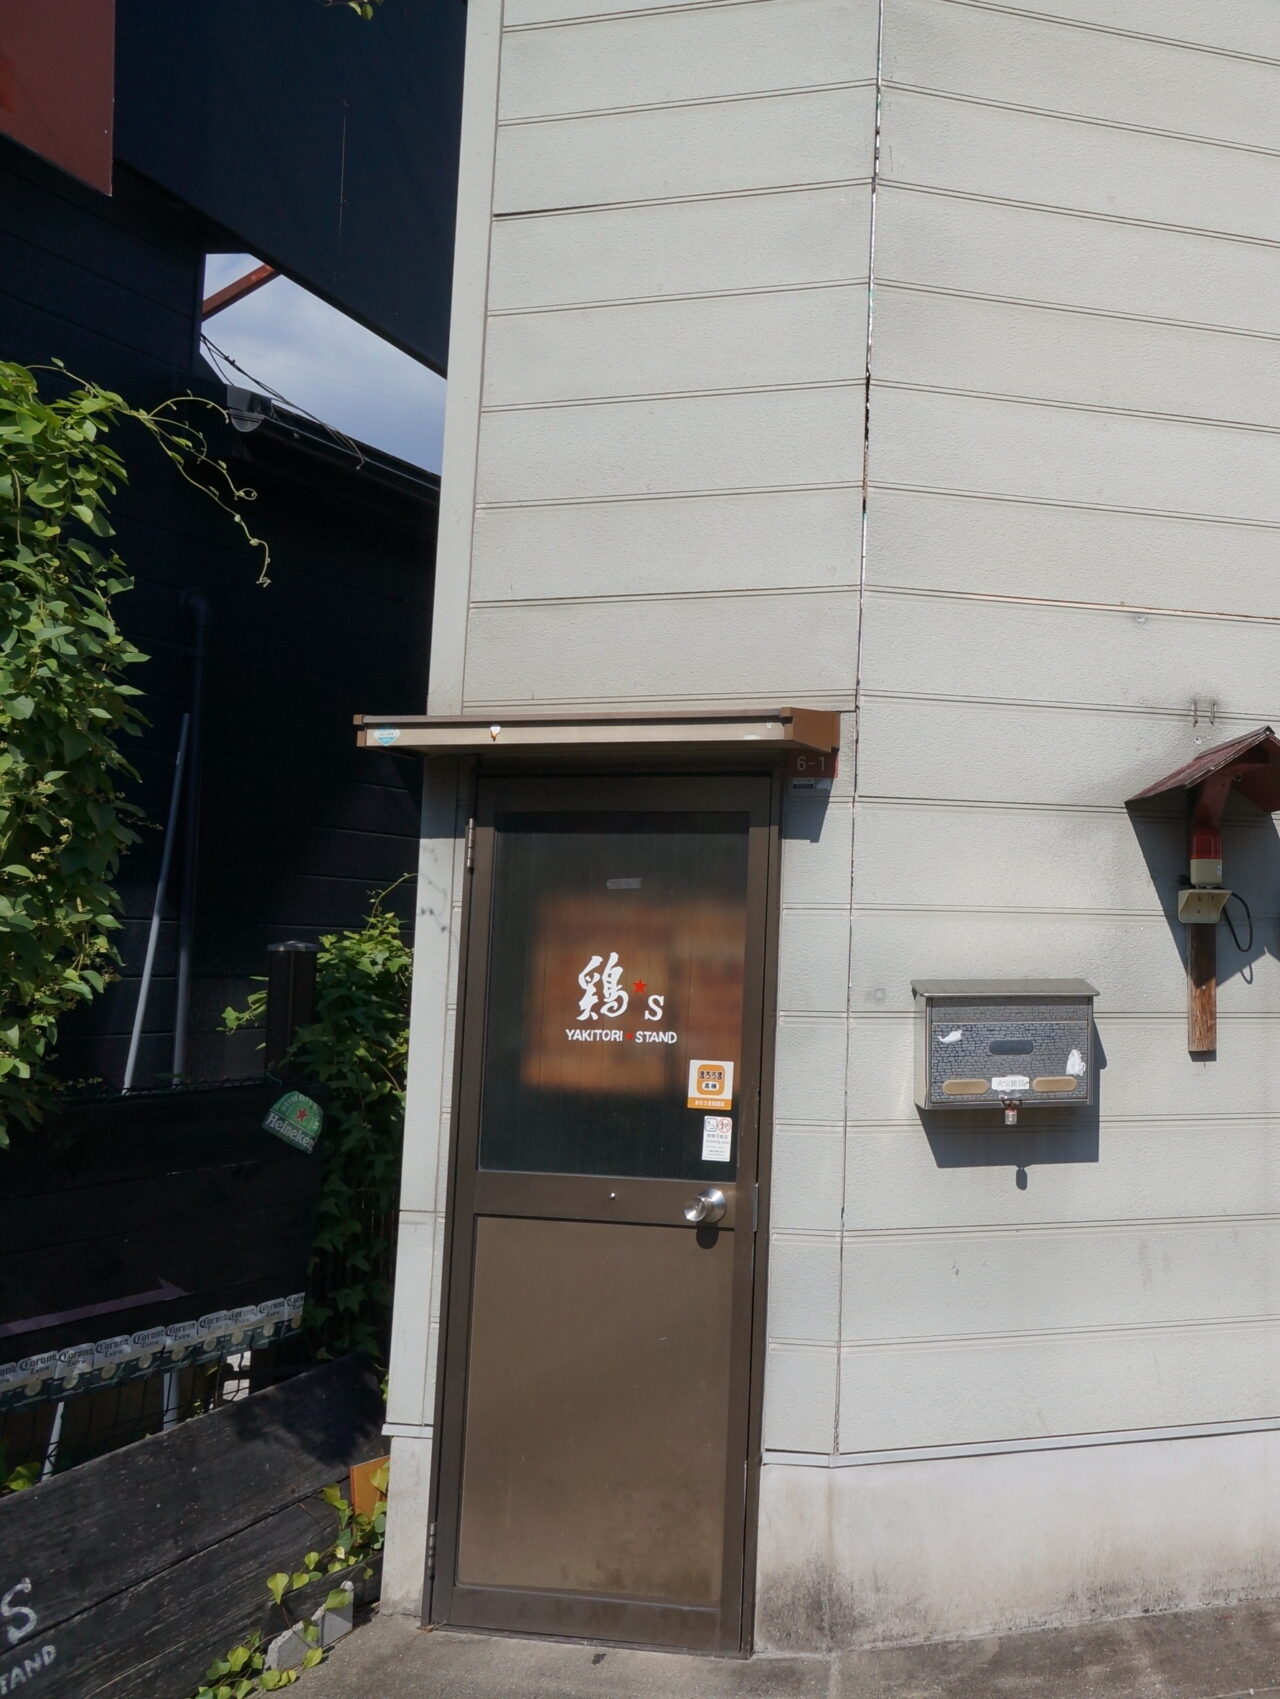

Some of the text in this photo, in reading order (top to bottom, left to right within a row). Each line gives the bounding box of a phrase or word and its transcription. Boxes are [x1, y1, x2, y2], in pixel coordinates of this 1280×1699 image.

[797, 756, 825, 771] 6-1
[565, 1028, 678, 1044] YAKITORI STAND
[265, 1112, 315, 1149] Heineken
[133, 1328, 165, 1345] Corona
[165, 1322, 196, 1337] Corona
[174, 1332, 191, 1341] Extra
[95, 1338, 130, 1354] Corona
[104, 1348, 123, 1358] Extra
[19, 1352, 59, 1371] Corona
[59, 1347, 95, 1362] Corona
